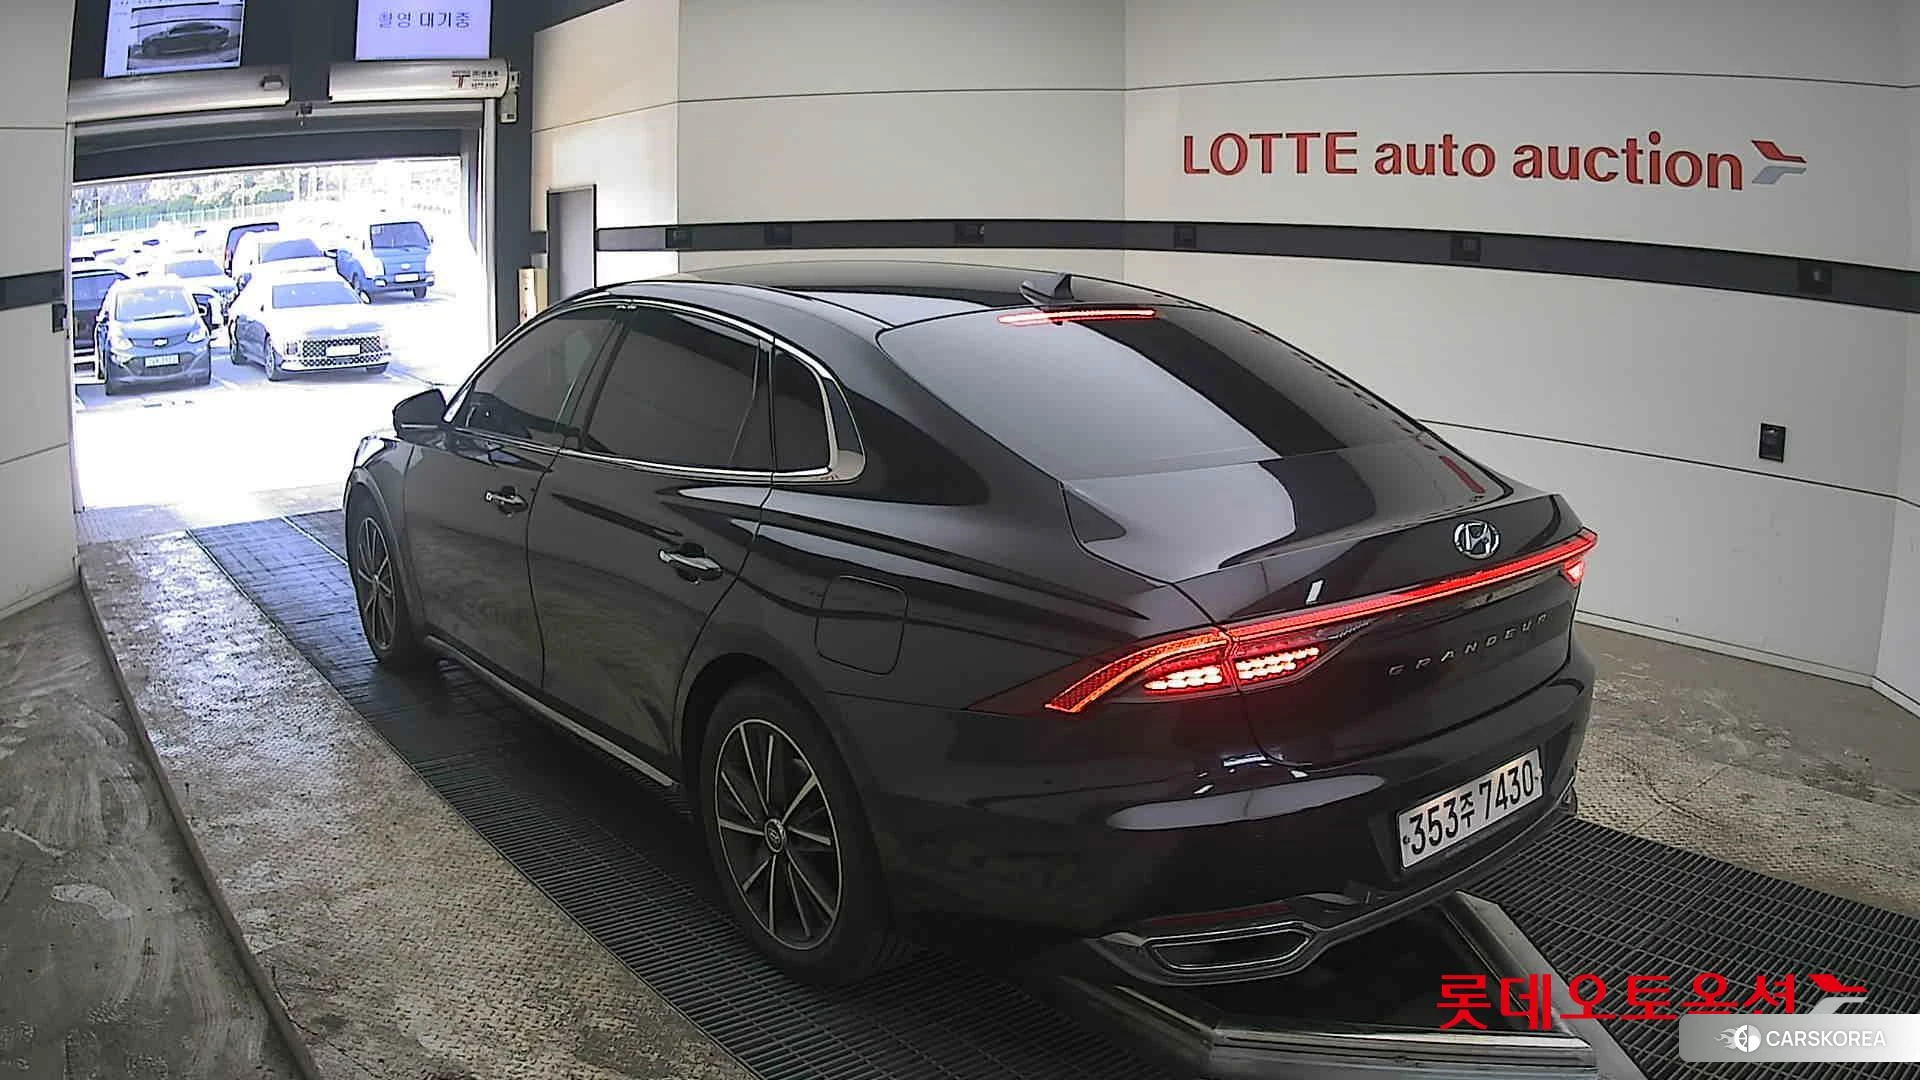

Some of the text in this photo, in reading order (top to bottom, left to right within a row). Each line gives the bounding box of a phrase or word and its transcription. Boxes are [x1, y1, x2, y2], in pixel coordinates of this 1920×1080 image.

[419, 11, 472, 29] 대기중
[1184, 130, 1743, 190] LOTTE auto auction
[1387, 613, 1547, 676] GRANDEUR
